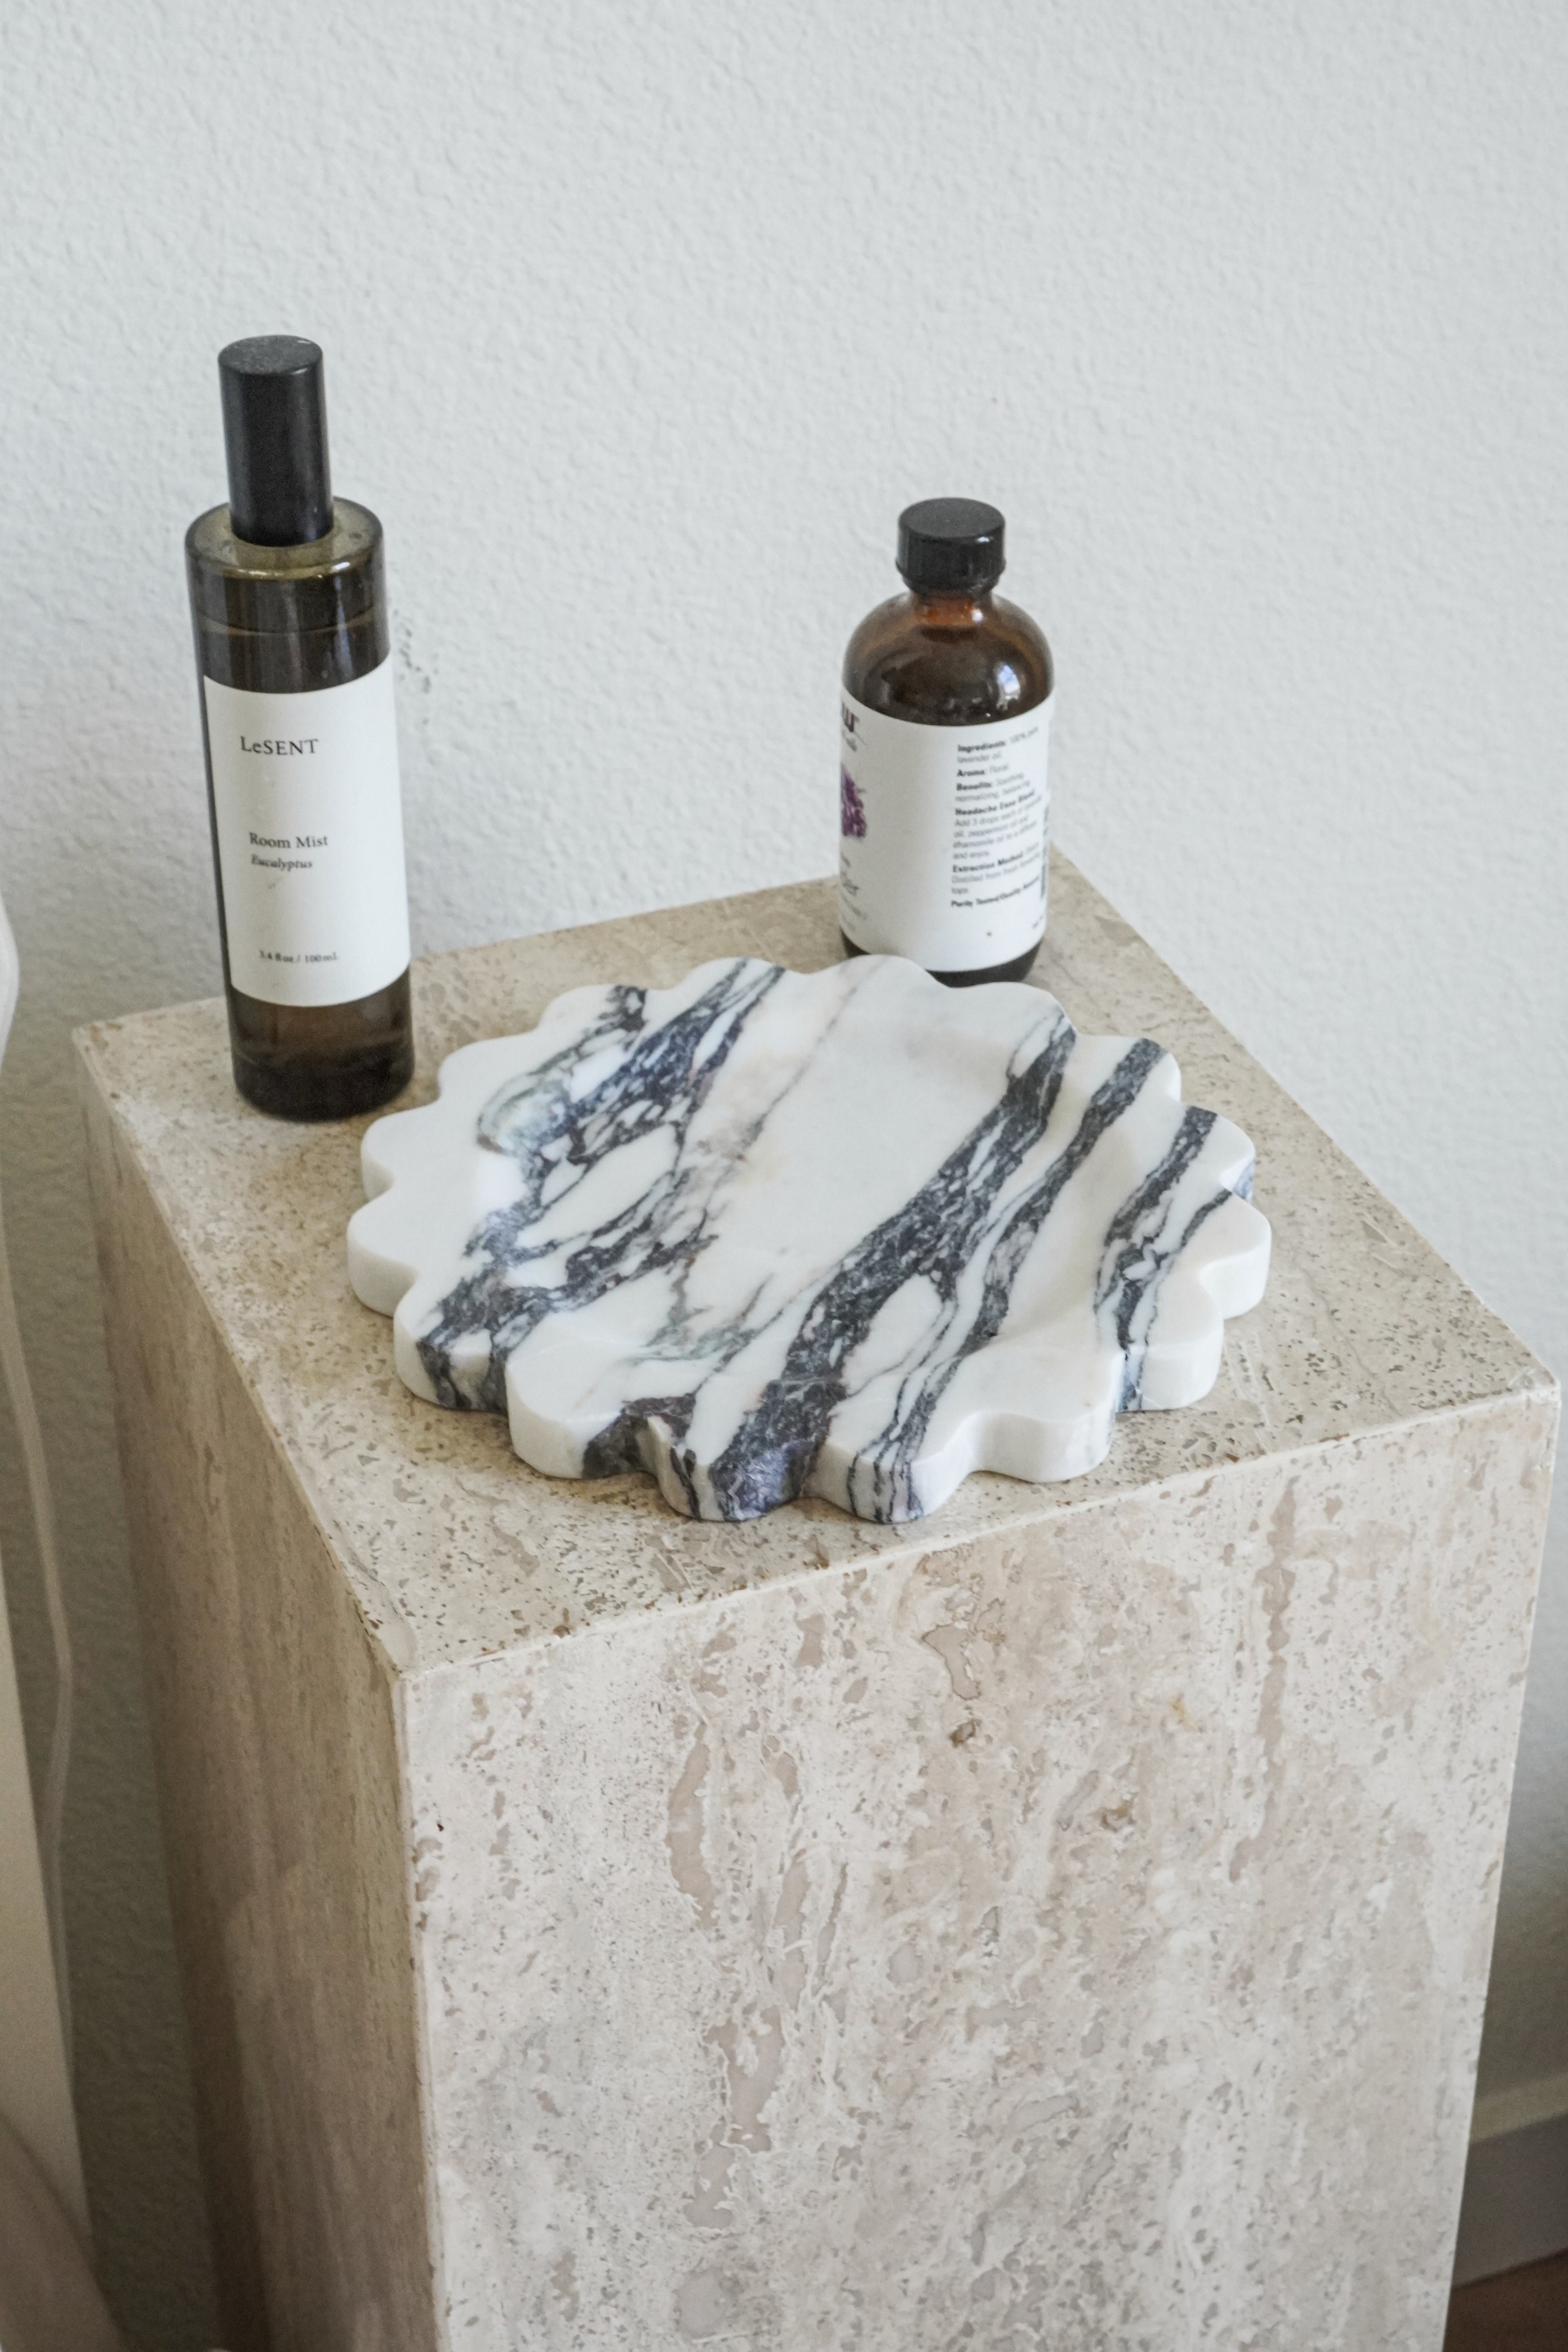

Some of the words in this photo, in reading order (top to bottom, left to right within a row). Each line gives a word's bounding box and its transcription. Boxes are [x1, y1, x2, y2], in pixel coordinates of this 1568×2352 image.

[240, 736, 319, 755] LeSENT
[249, 831, 291, 848] Room
[296, 835, 328, 848] Mist
[251, 854, 312, 871] Eucalyptus
